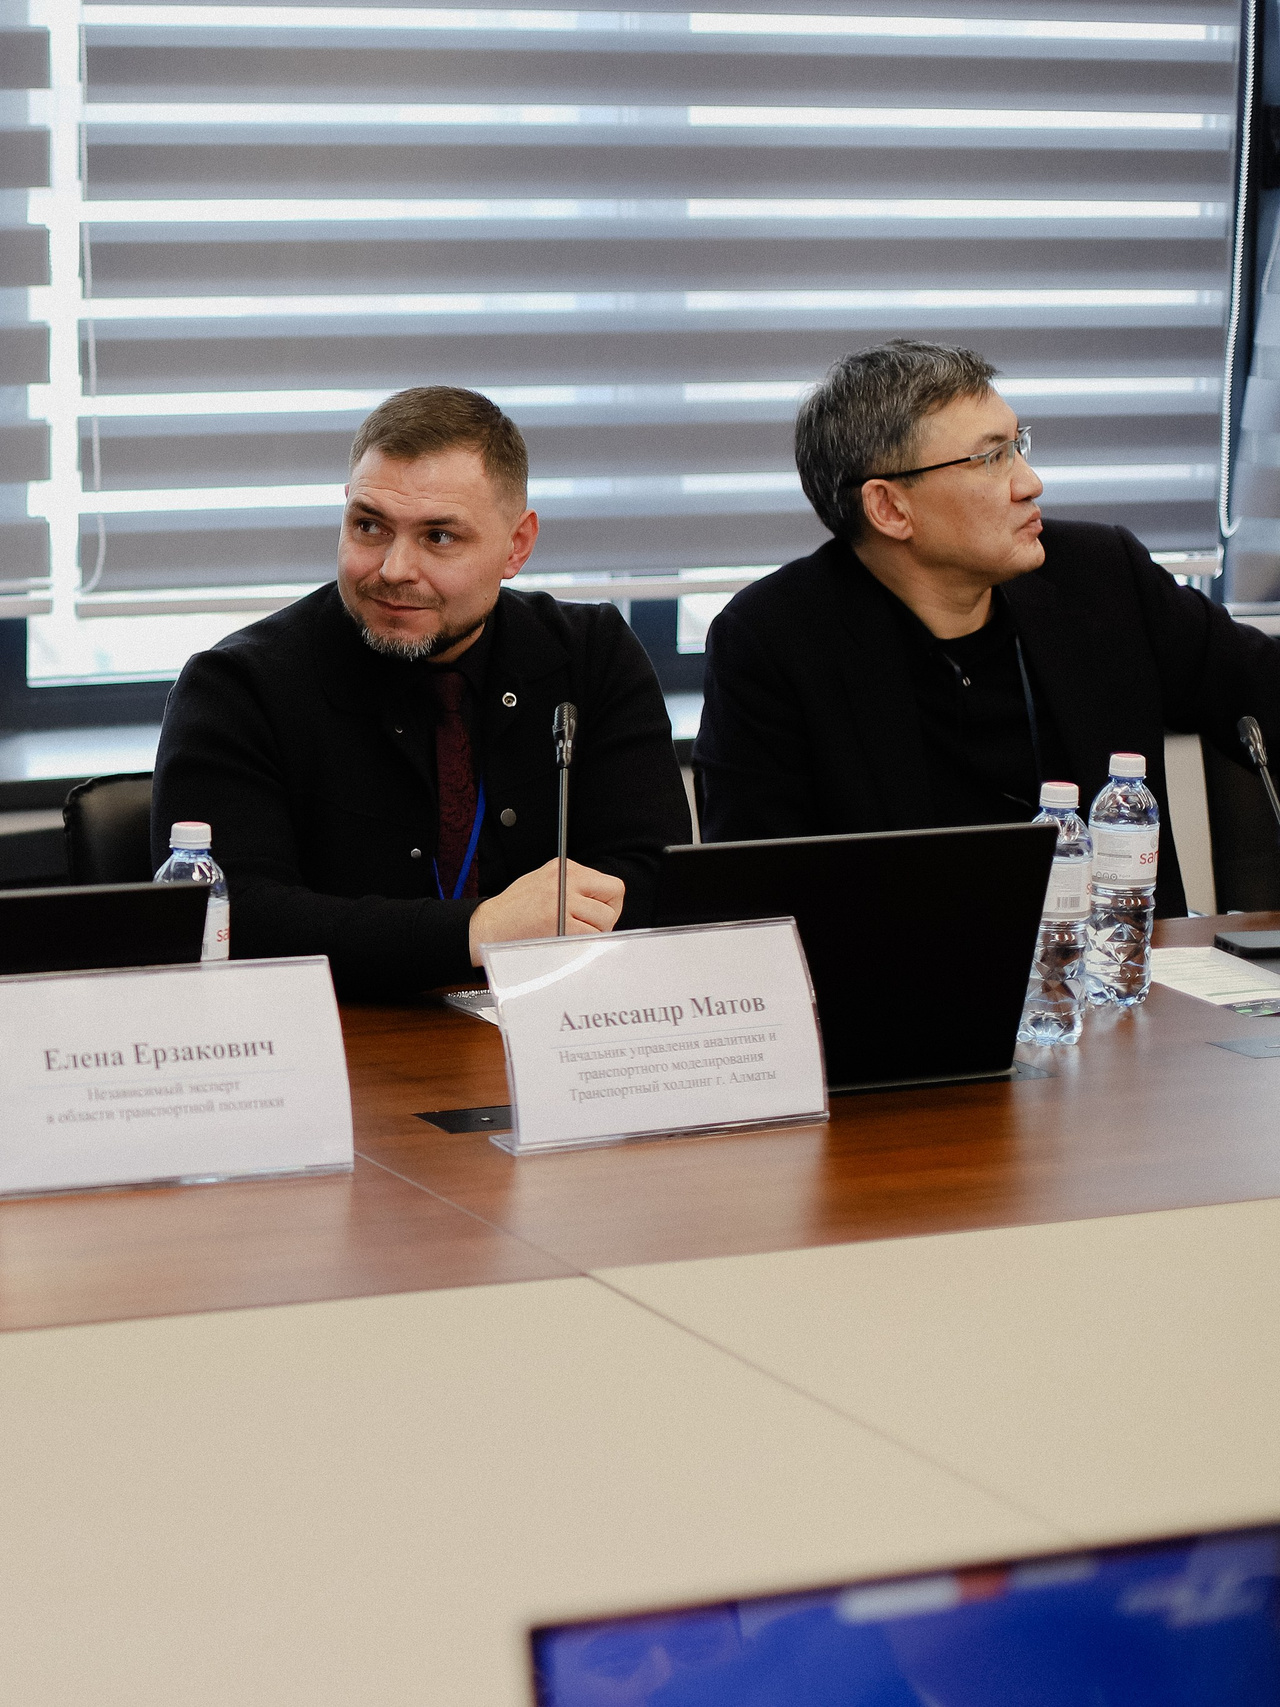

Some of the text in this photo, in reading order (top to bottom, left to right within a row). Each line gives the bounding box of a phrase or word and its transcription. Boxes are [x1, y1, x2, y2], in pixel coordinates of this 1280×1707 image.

[559, 995, 766, 1032] Александр Матов
[44, 1039, 275, 1071] Елена Ерзакович
[559, 1031, 777, 1064] Начальник управления аналитики и
[577, 1051, 764, 1084] транспортного моделирования
[87, 1082, 184, 1102] Независимый
[569, 1069, 777, 1104] Транспортный холдинг г. Алматы
[58, 1106, 115, 1124] области
[118, 1098, 216, 1122] транспортной
[218, 1096, 286, 1112] политики
